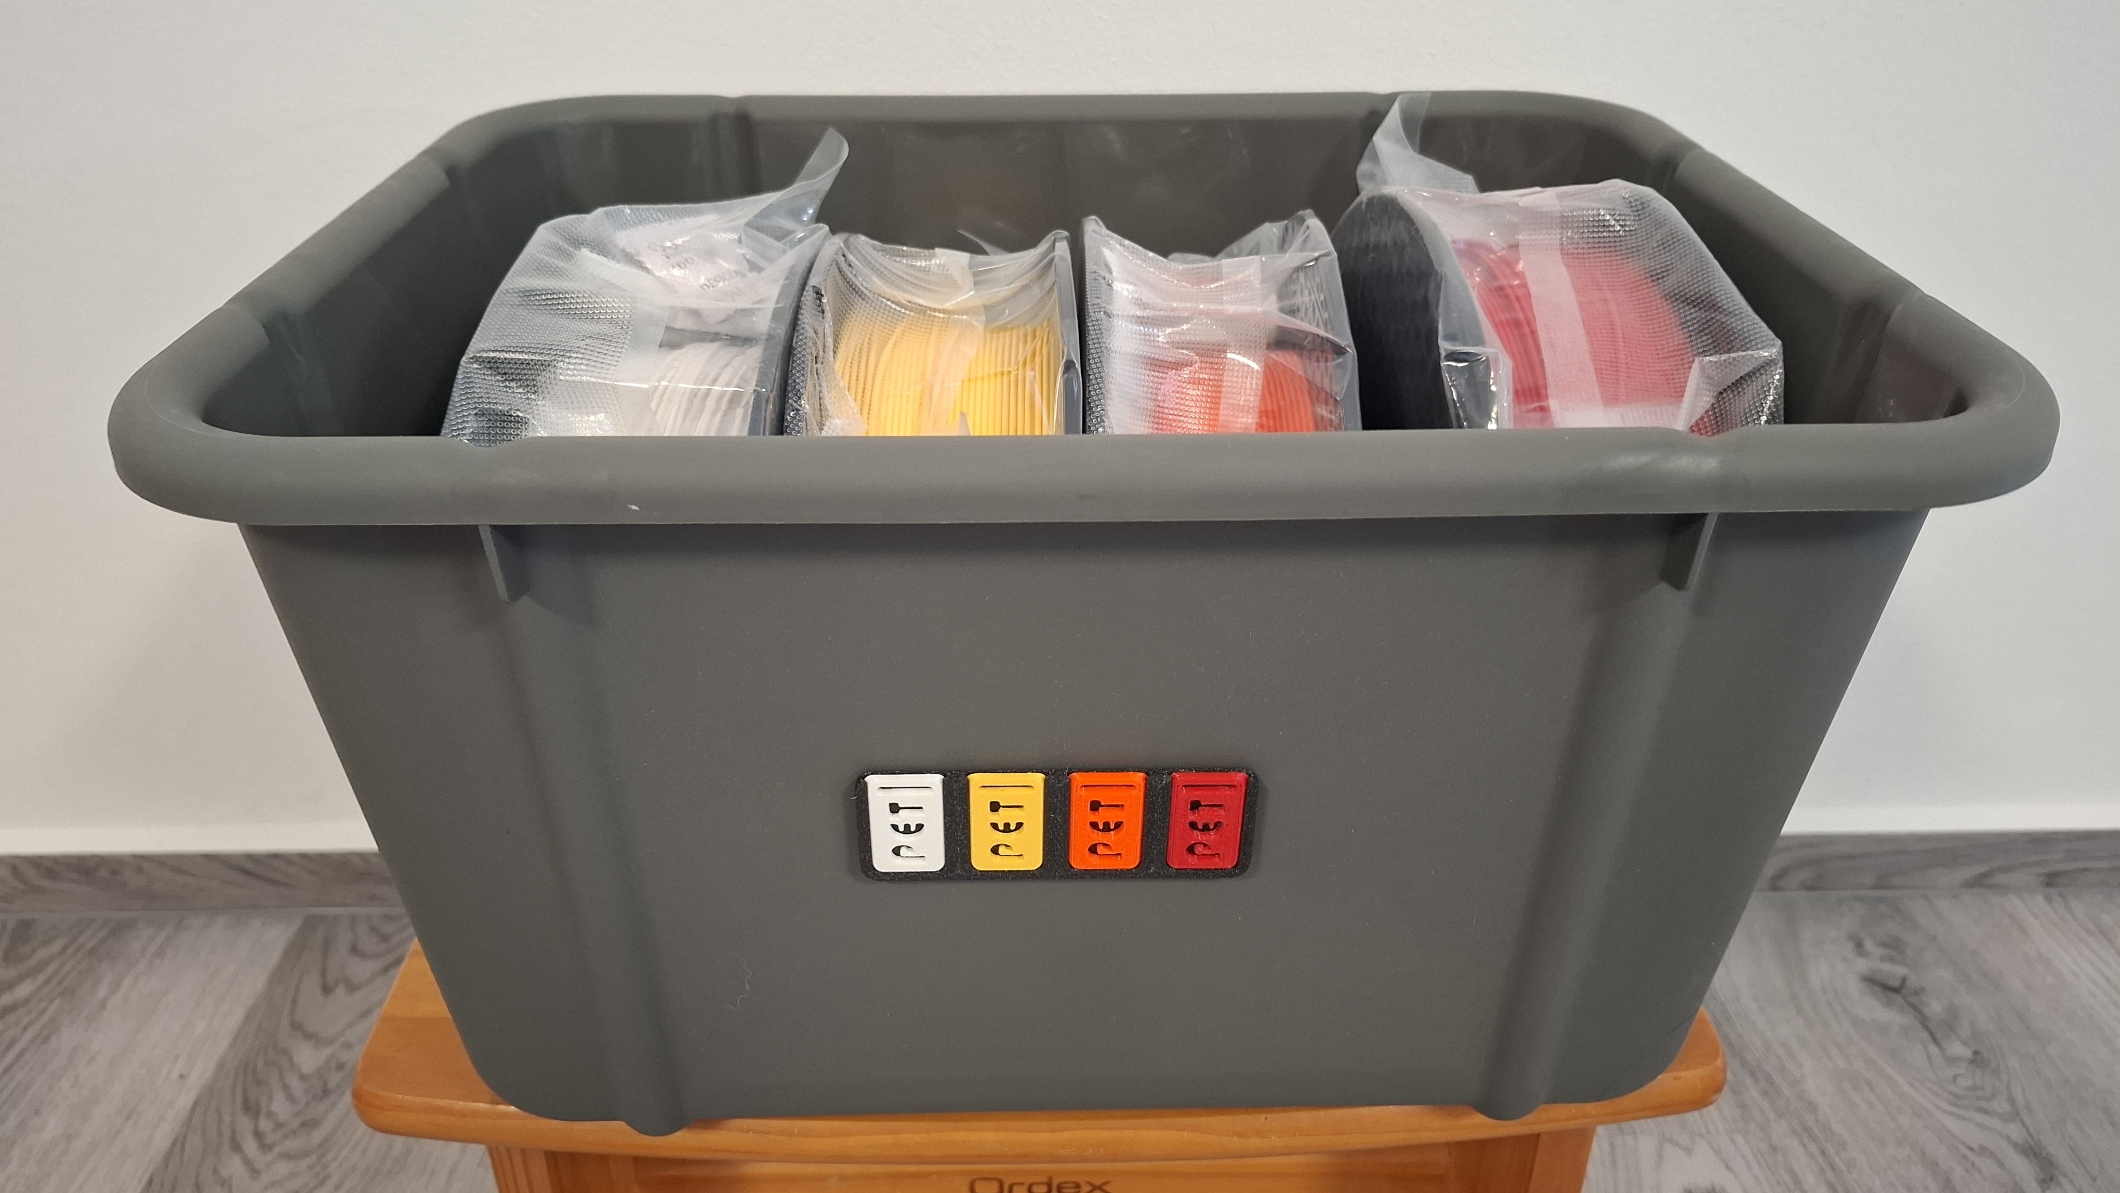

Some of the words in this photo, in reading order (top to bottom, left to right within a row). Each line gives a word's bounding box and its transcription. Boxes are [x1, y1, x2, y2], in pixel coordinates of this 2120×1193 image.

[888, 801, 926, 859] PET
[989, 800, 1025, 858] PET
[1087, 799, 1126, 860] PET
[1185, 799, 1225, 859] PET
[969, 1176, 1113, 1193] Ordex
